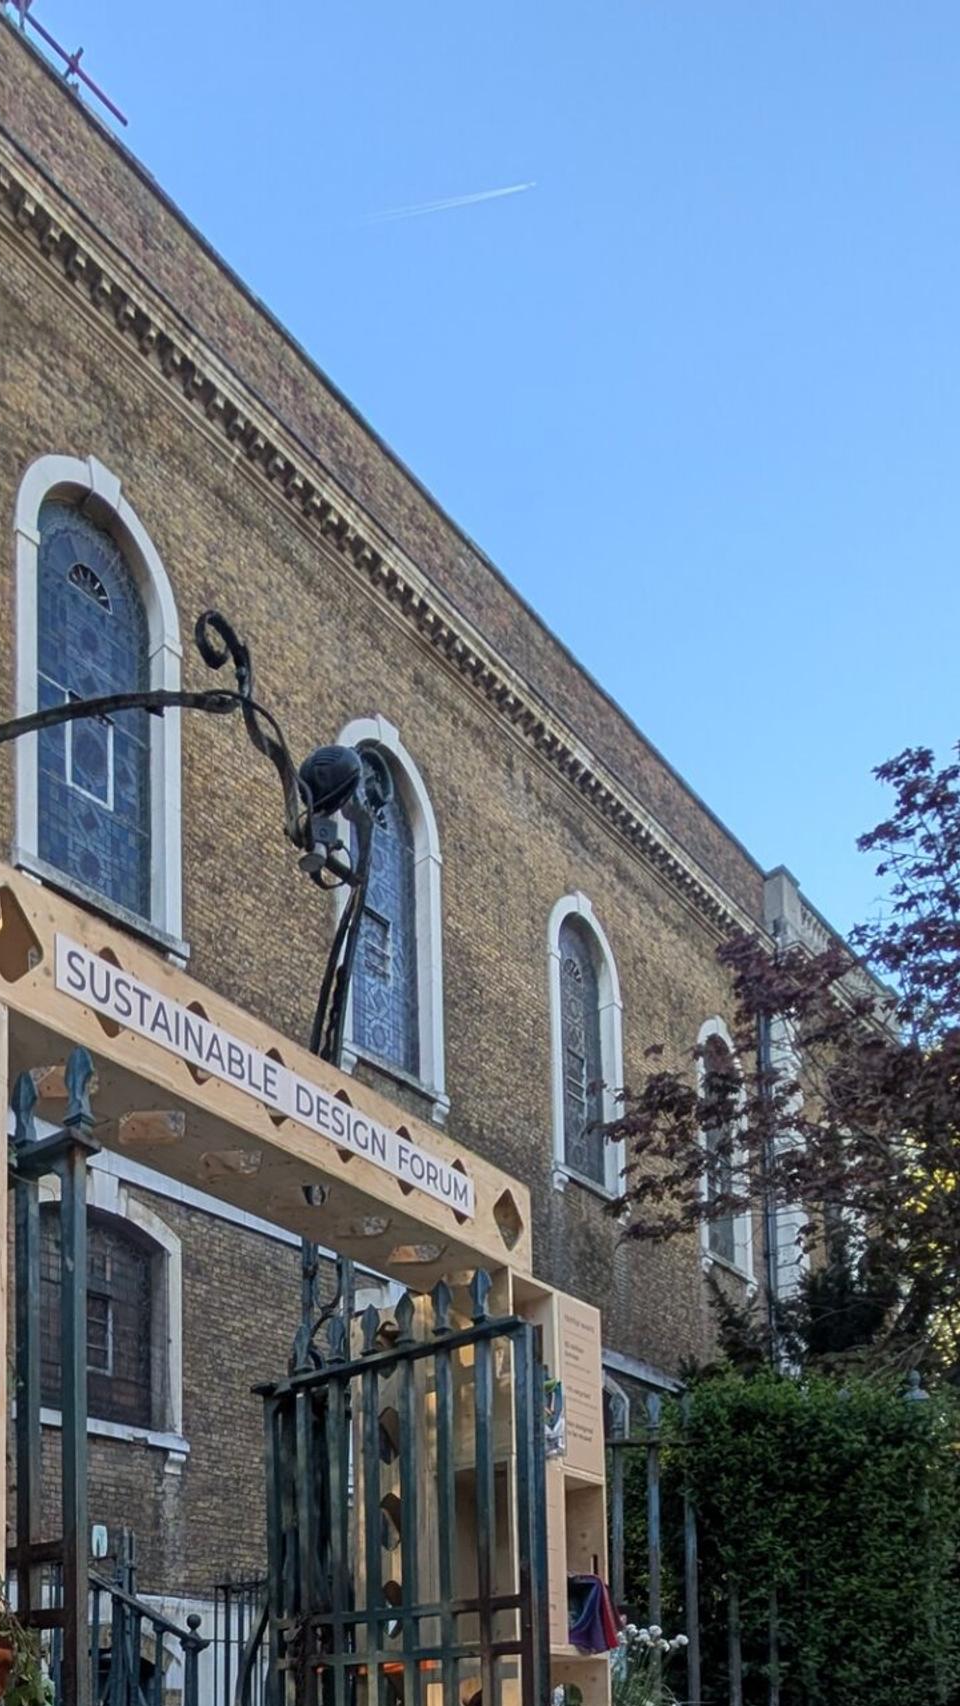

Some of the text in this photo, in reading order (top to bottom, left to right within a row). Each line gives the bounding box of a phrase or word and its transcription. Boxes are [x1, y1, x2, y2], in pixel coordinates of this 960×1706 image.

[66, 950, 468, 1207] SUSTAINABLE DESIGN FORUM
